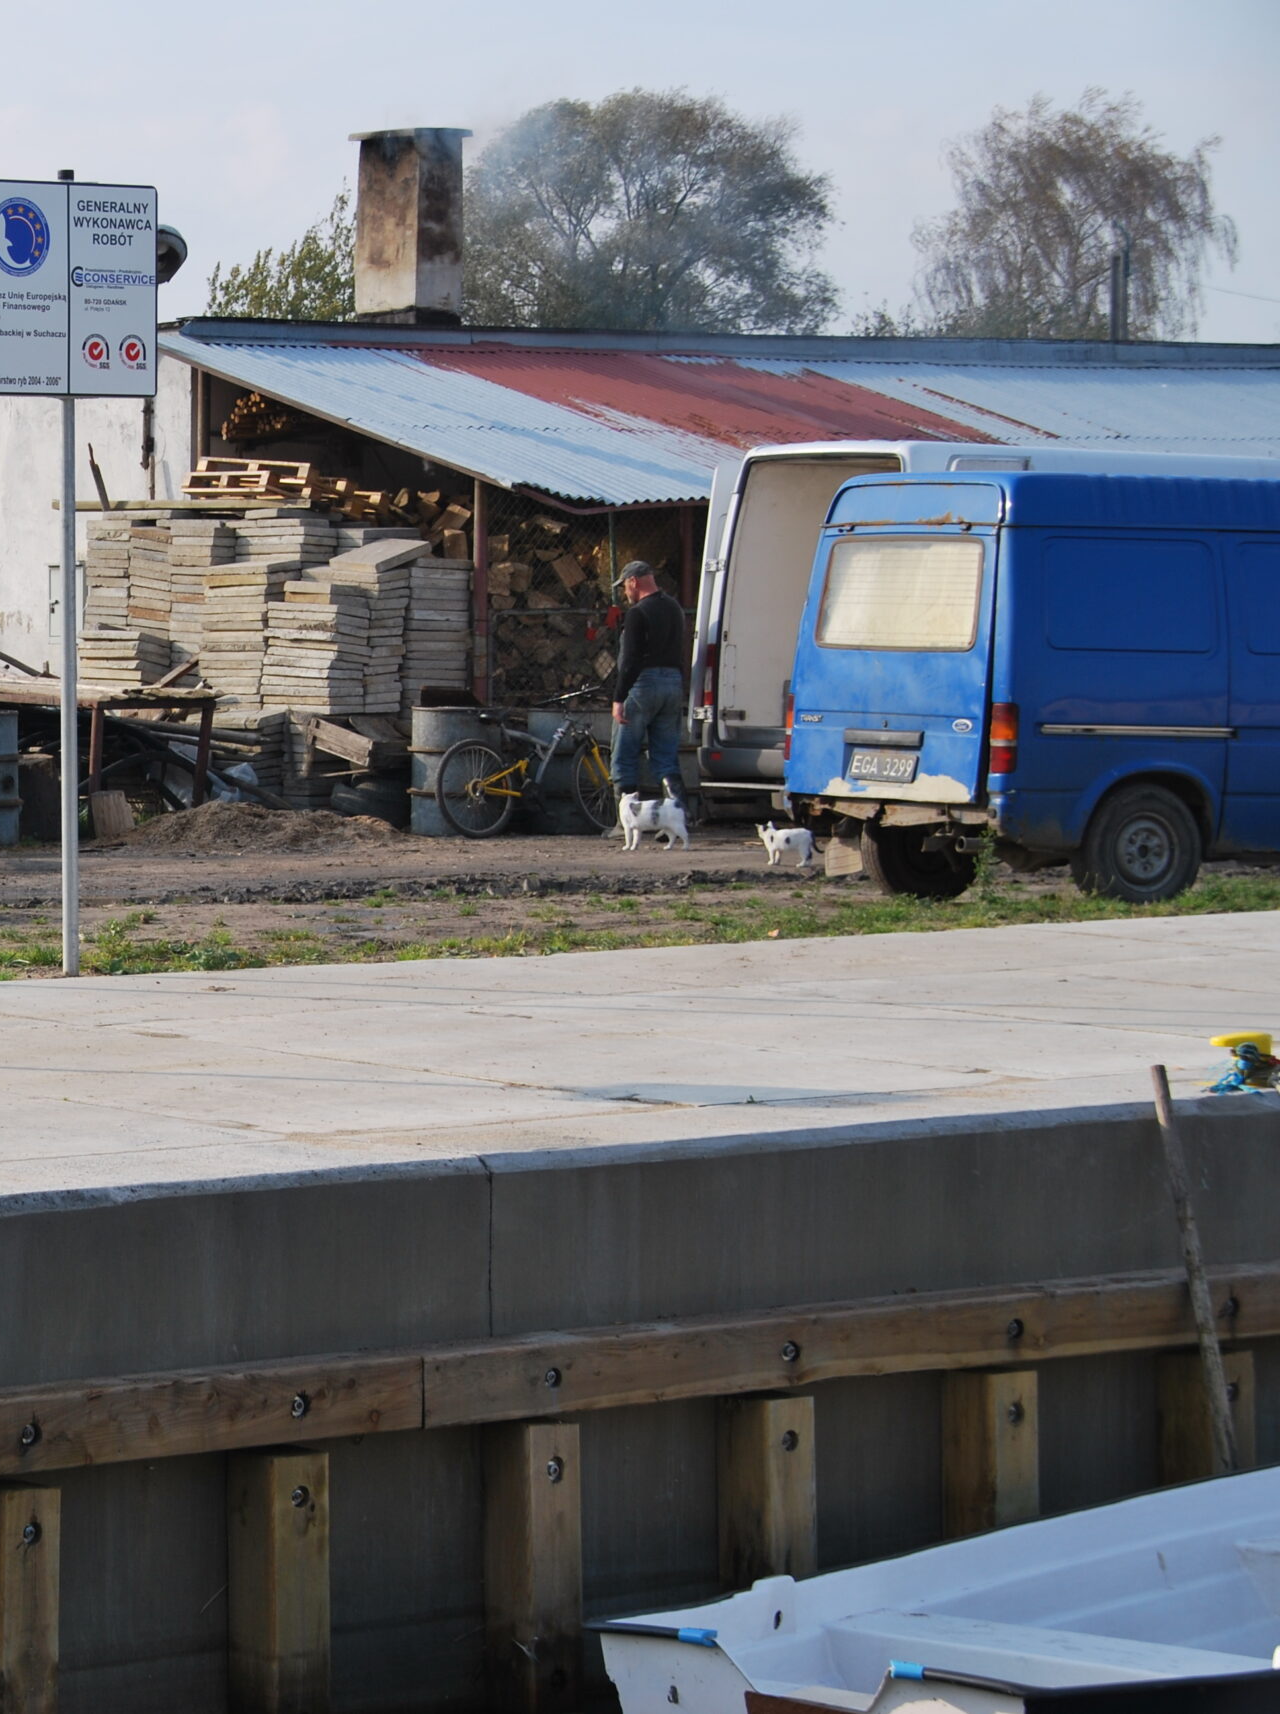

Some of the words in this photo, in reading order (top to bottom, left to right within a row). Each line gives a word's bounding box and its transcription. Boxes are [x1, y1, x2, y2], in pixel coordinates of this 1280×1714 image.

[77, 200, 148, 214] GENERALNY
[73, 216, 152, 231] WYKONAWCA
[92, 232, 134, 246] ROBÓT
[84, 272, 156, 285] CONSERVICE
[8, 291, 24, 301] Unię
[26, 292, 66, 302] Europejską
[2, 302, 51, 312] Finansowego
[33, 330, 66, 338] Suchaczu
[18, 376, 27, 386] ryb
[28, 376, 41, 385] 2004
[851, 755, 878, 774] EGA
[882, 757, 914, 777] 3299
